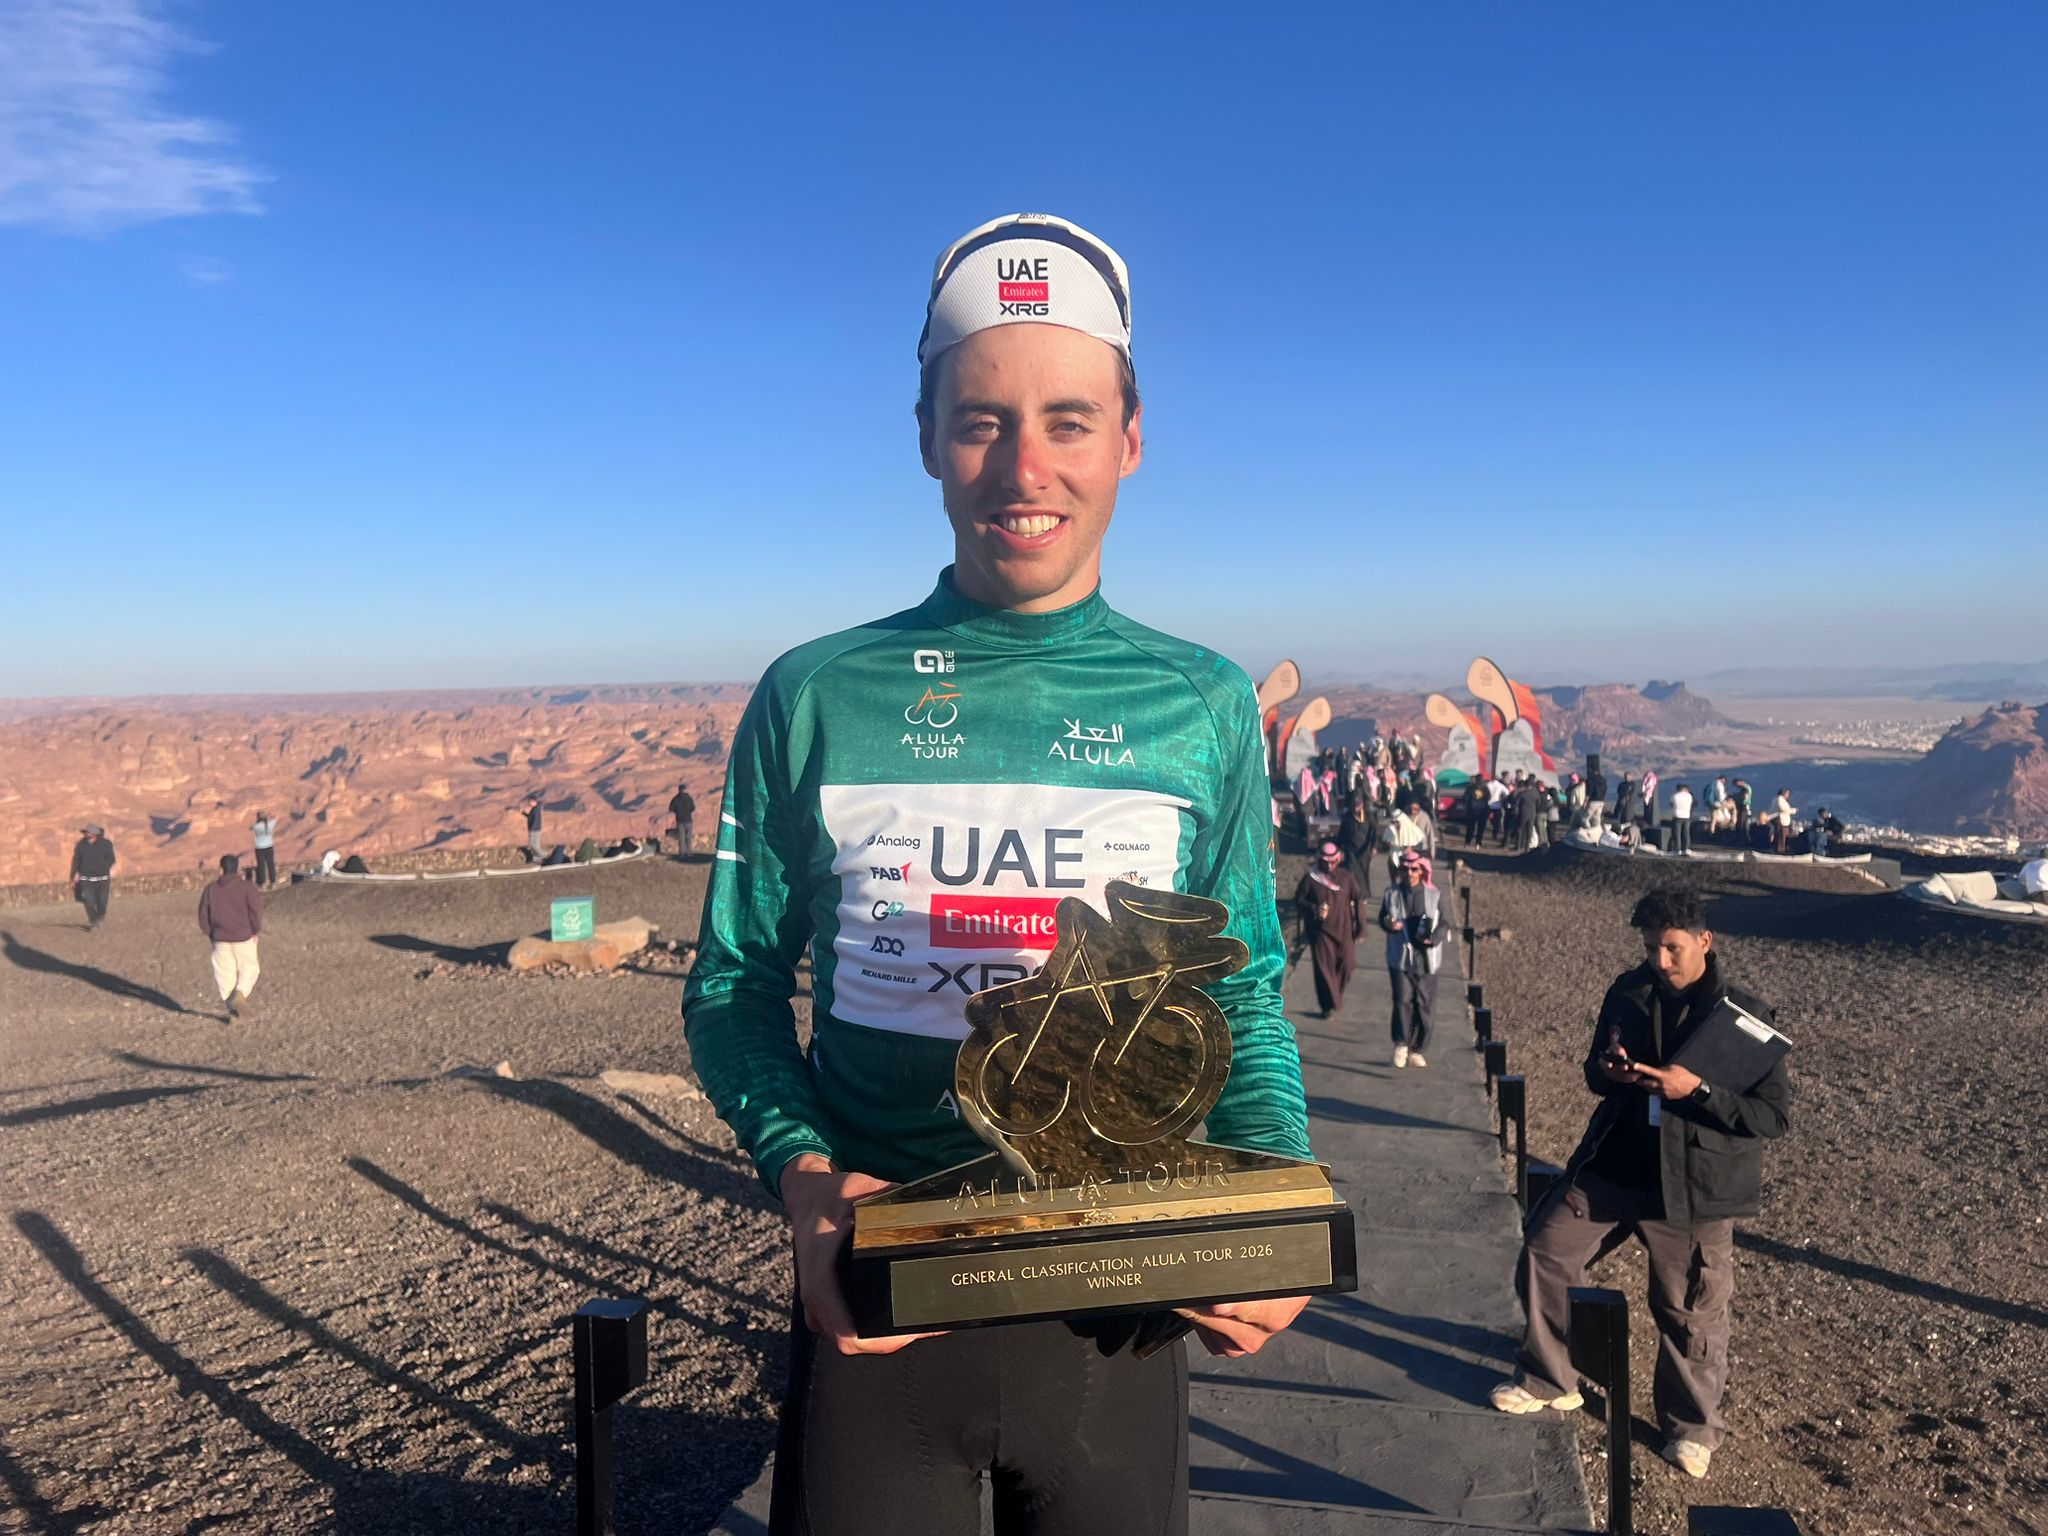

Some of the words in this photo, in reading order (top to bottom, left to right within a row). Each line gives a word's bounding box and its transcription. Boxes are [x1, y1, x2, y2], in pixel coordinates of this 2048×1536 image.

[998, 258, 1048, 281] UAE
[1003, 286, 1045, 297] Emirates
[1000, 302, 1049, 316] XRG
[900, 733, 967, 746] ALULA
[912, 746, 959, 760] TOUR
[1047, 741, 1136, 769] ALULA
[876, 835, 921, 849] Analog
[1113, 843, 1150, 851] COLNAGO
[930, 826, 1086, 889] UAE
[870, 866, 902, 881] FAB
[871, 899, 905, 921] G42
[943, 909, 1055, 935] Emirate
[870, 935, 905, 957] ADQ
[861, 969, 892, 982] RICHARD
[893, 976, 917, 984] MILLE
[927, 962, 1042, 996] XR
[1118, 1159, 1231, 1195] TOUR
[951, 1269, 1015, 1287] GENERAL
[1021, 1257, 1134, 1280] CLASSIFICATION
[1141, 1253, 1187, 1268] ALULA
[1193, 1248, 1232, 1262] TOUR
[1240, 1244, 1273, 1259] 2026
[1087, 1273, 1142, 1289] WINNER
